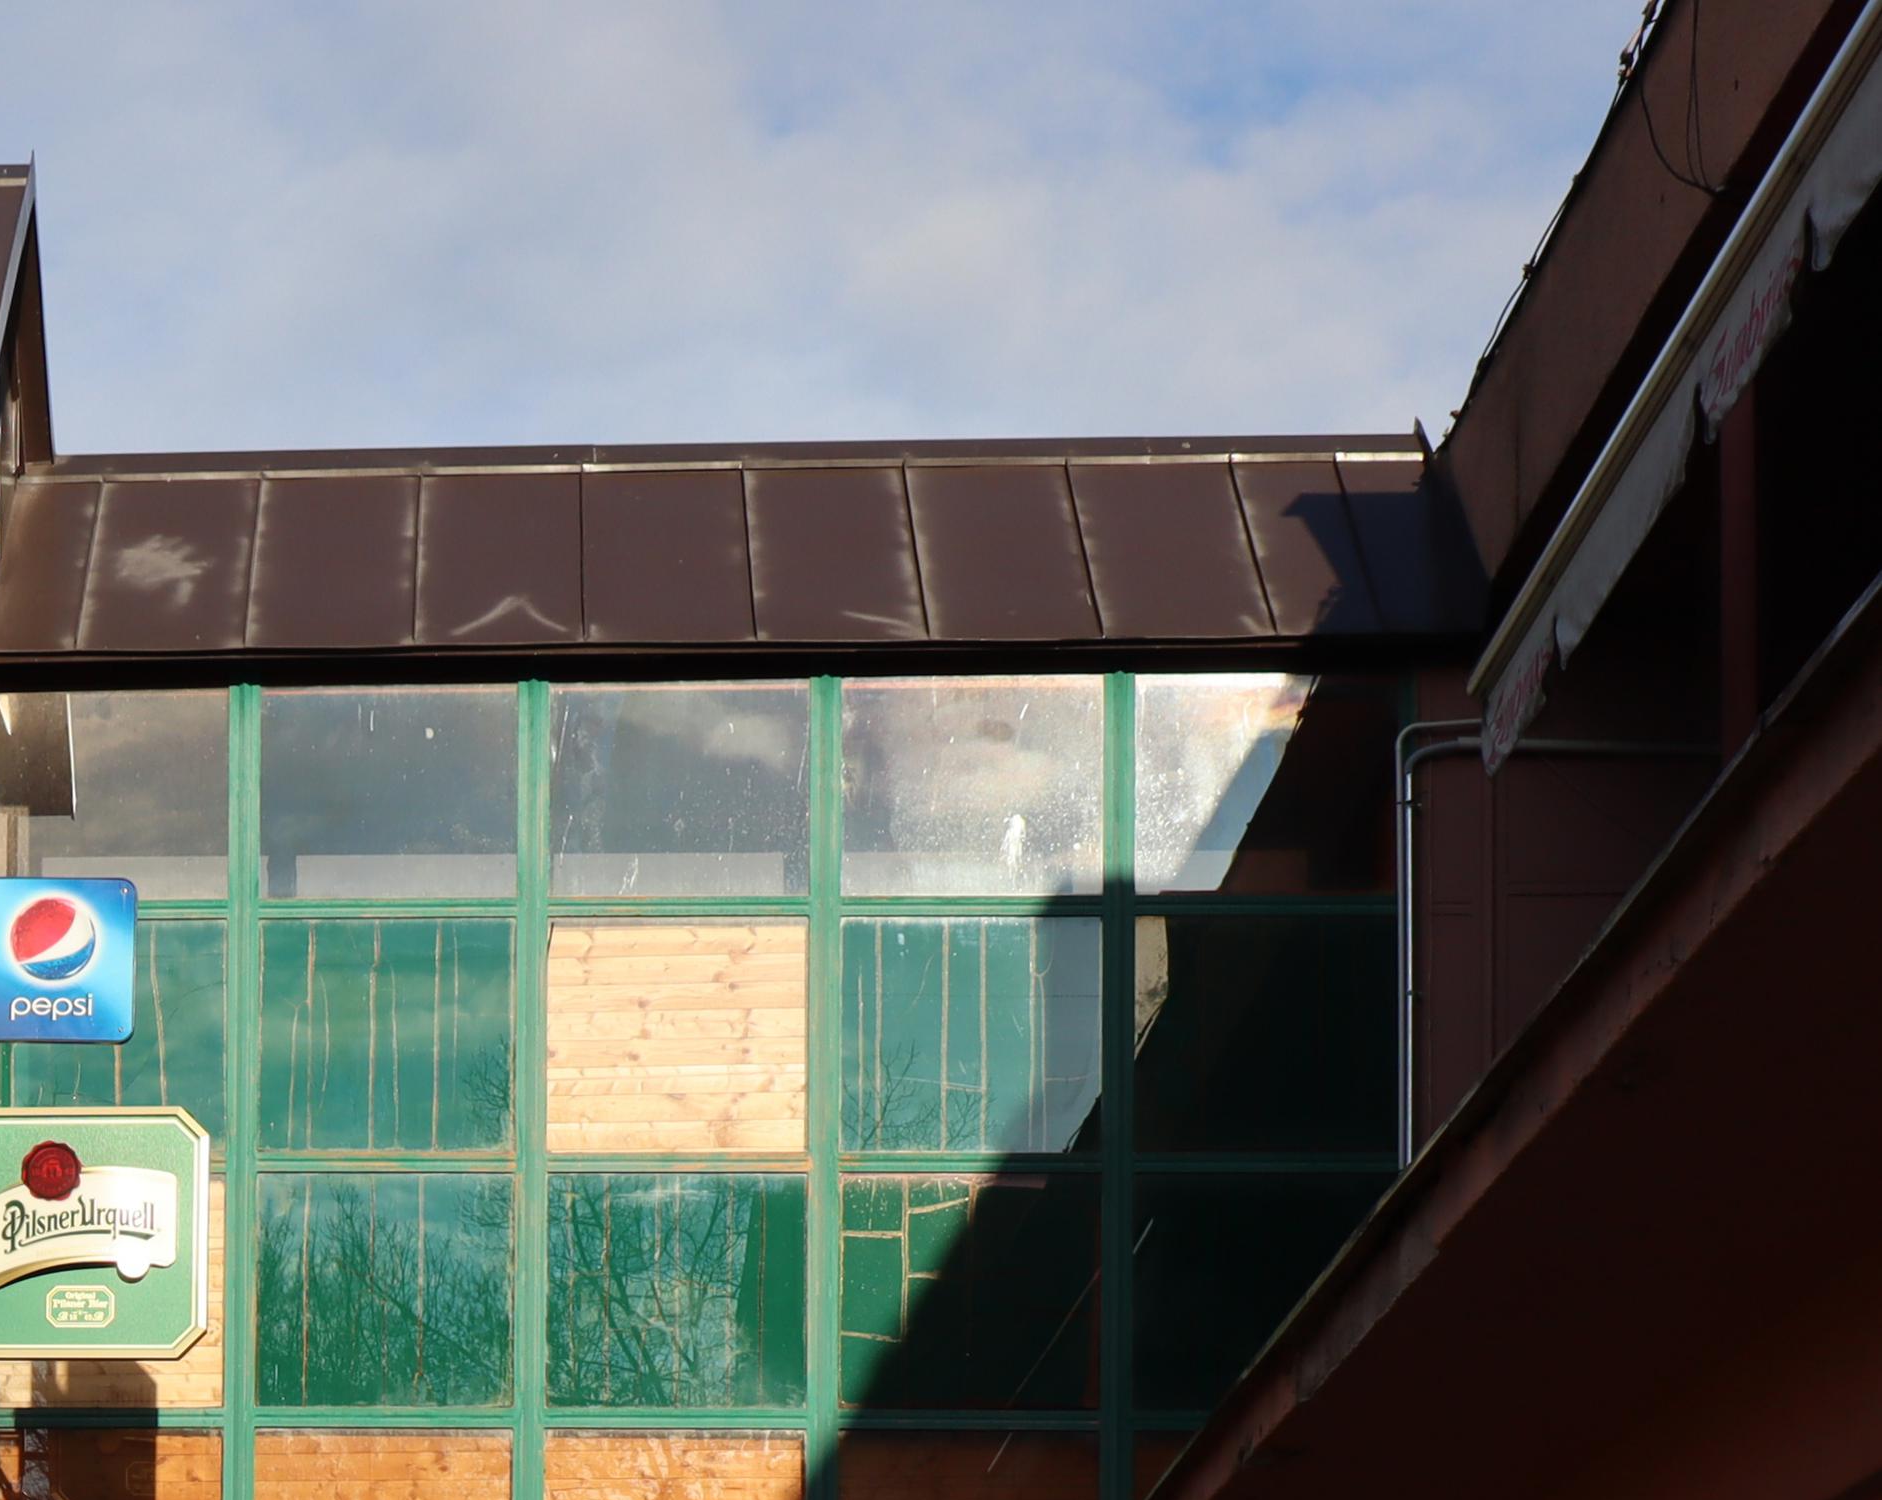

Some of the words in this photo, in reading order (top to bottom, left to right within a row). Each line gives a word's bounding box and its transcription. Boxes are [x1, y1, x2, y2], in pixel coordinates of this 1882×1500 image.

[10, 992, 94, 1021] pepsi
[1, 1199, 78, 1255] Pilsner
[77, 1195, 154, 1240] Urquell
